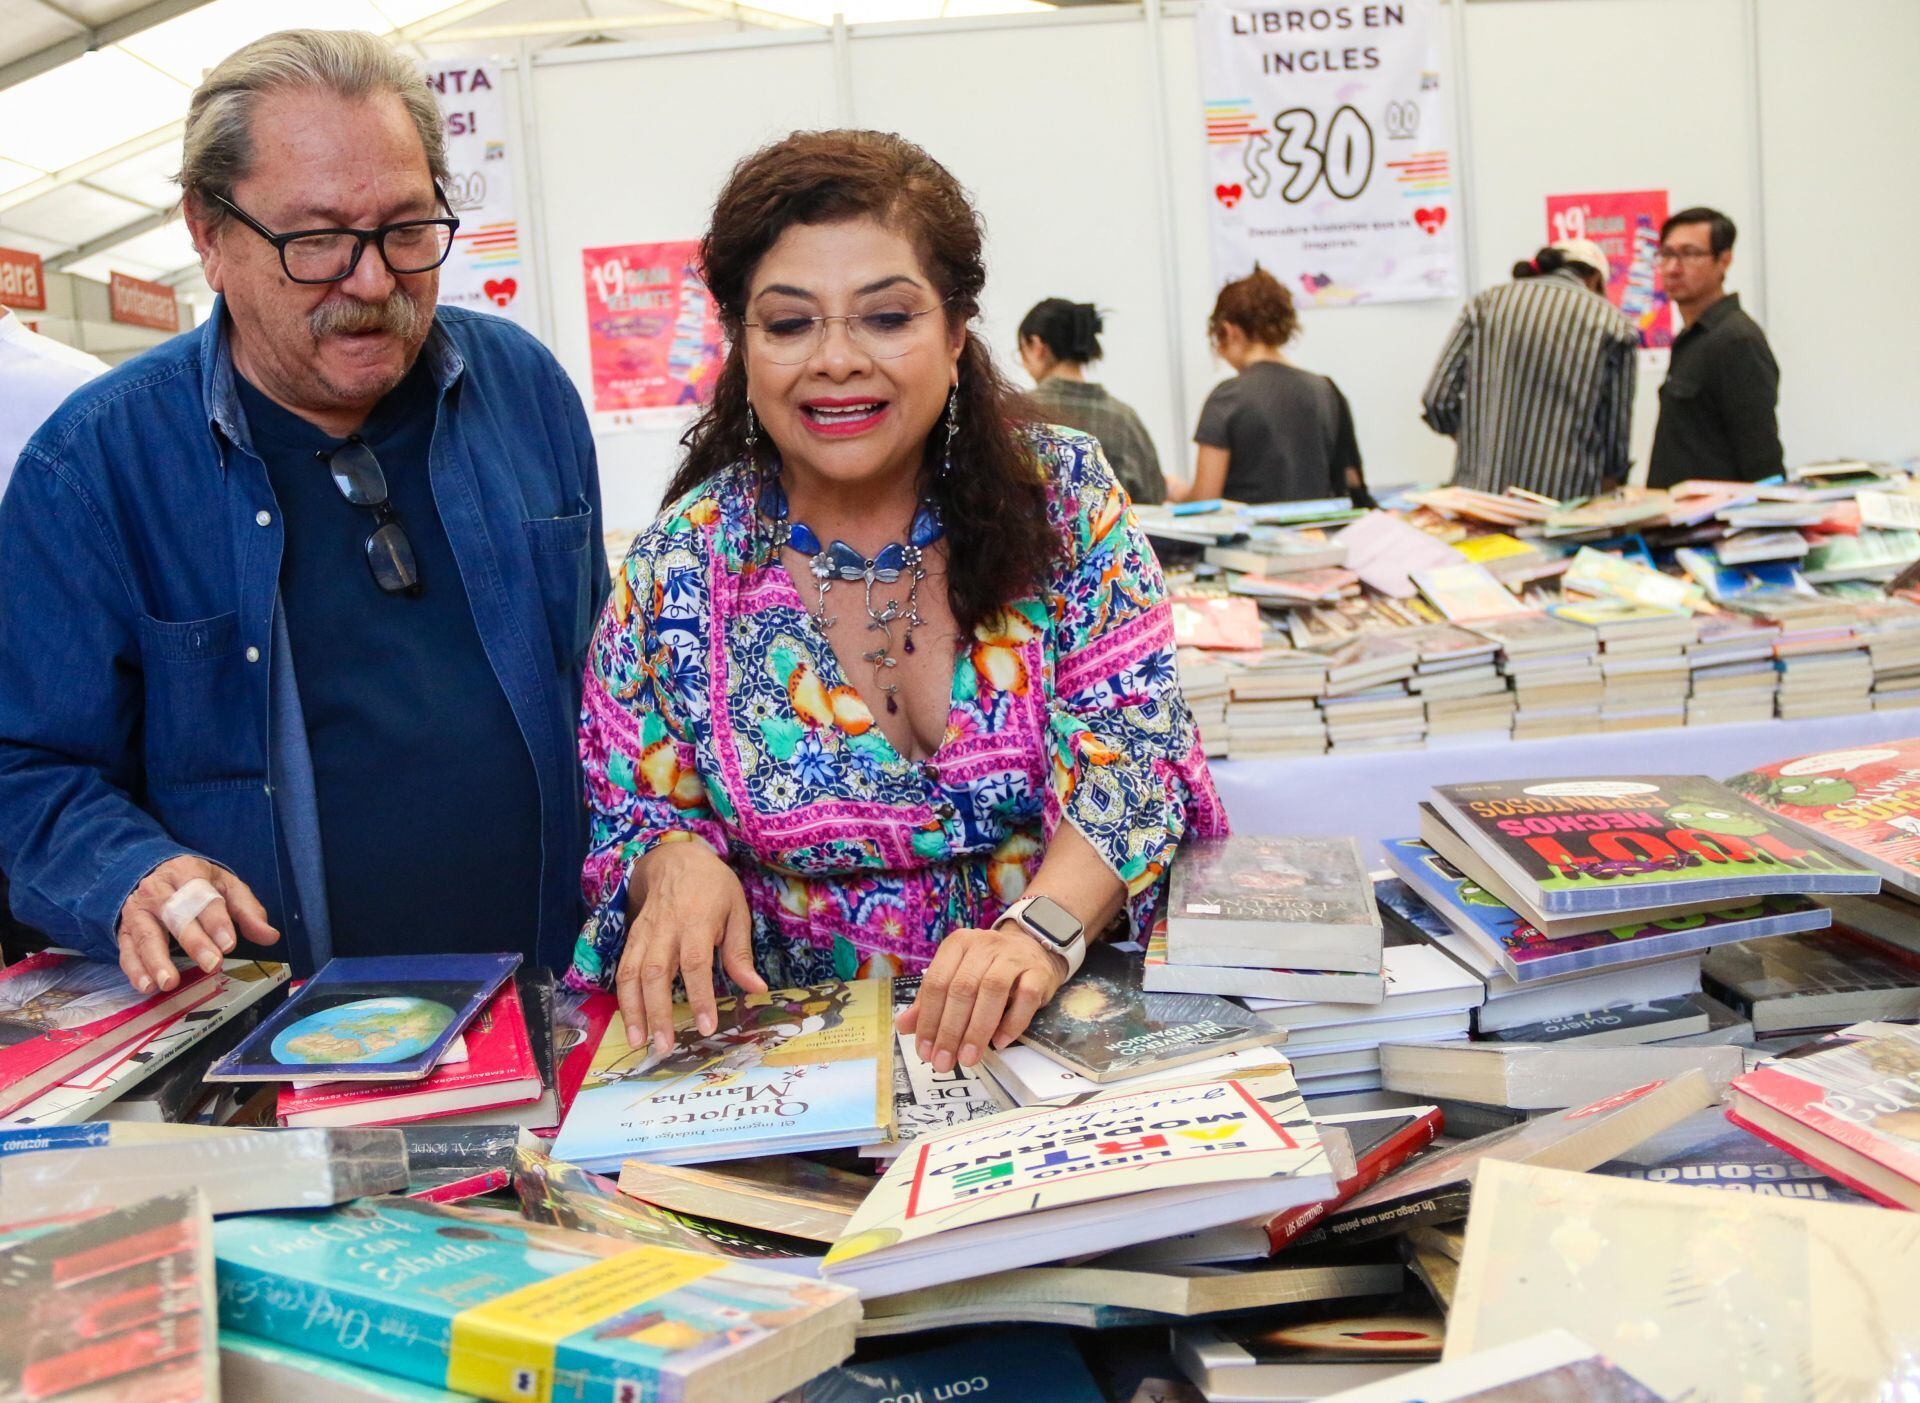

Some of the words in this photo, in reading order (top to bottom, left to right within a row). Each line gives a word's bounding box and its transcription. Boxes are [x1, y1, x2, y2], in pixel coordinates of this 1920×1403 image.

[1232, 7, 1353, 35] LIBROS
[1364, 5, 1405, 27] EN
[1263, 47, 1381, 74] INGLES
[1495, 810, 1663, 837] HECHOS
[1544, 1015, 1622, 1033] Quiero
[1119, 1029, 1200, 1056] UNIVERSO
[649, 1080, 796, 1105] Mancha
[926, 1086, 971, 1100] DE
[659, 1098, 809, 1126] Quijote
[711, 1121, 774, 1134] ingenioso
[1036, 1115, 1144, 1140] PARA
[626, 1135, 649, 1143] don
[928, 1110, 1248, 1177] MODERNO
[1189, 1141, 1247, 1152] EL
[950, 1123, 1246, 1189] ARTE
[1031, 1150, 1172, 1180] LIBRO
[953, 1180, 1013, 1200] DE
[1377, 1210, 1395, 1221] con
[1395, 1203, 1420, 1217] ciego
[1420, 1199, 1436, 1211] Un
[1331, 1217, 1360, 1234] pistola
[1361, 1215, 1378, 1226] una
[933, 1376, 989, 1402] con
